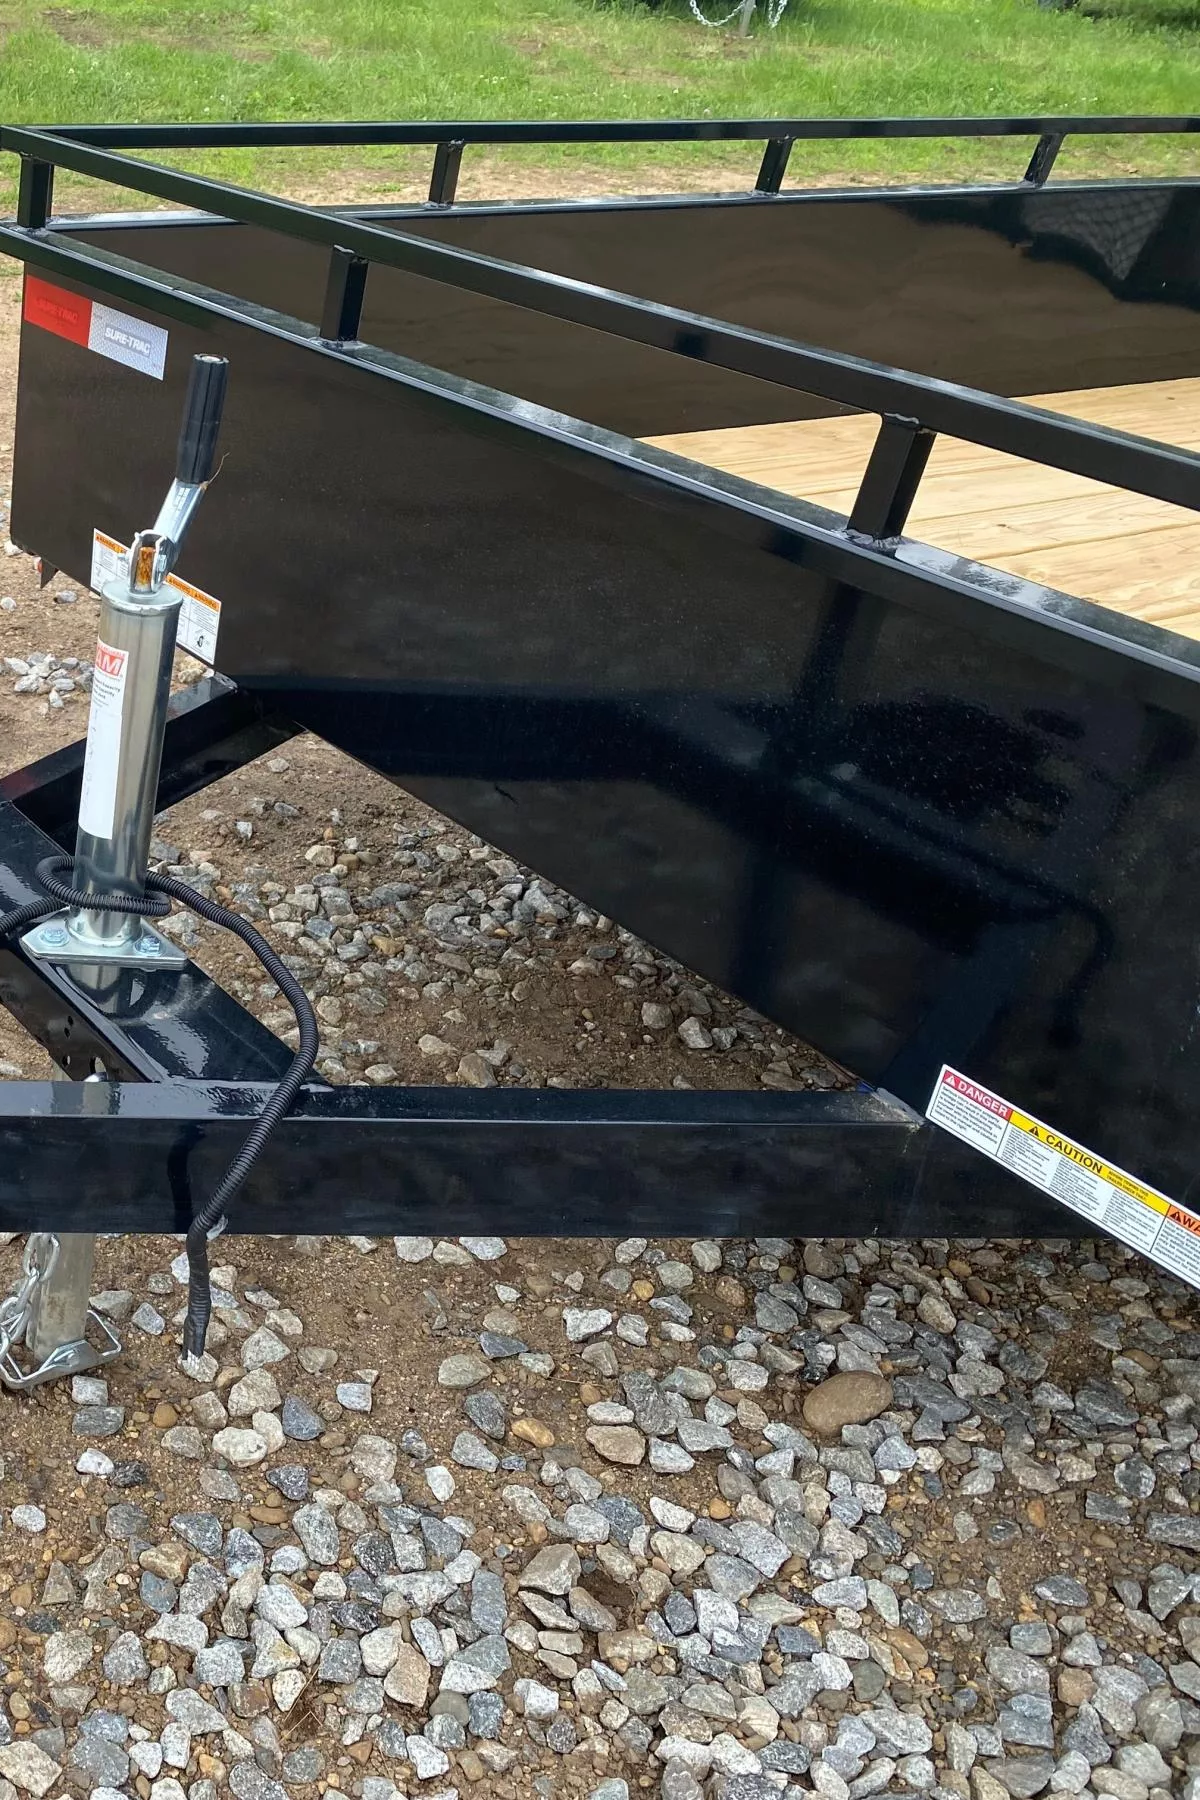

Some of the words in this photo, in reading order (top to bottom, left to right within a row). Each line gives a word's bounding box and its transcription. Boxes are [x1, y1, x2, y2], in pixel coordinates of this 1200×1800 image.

[104, 327, 151, 355] SURE-TRAC
[957, 1080, 1009, 1117] DANGER
[1045, 1134, 1103, 1174] CAUTION
